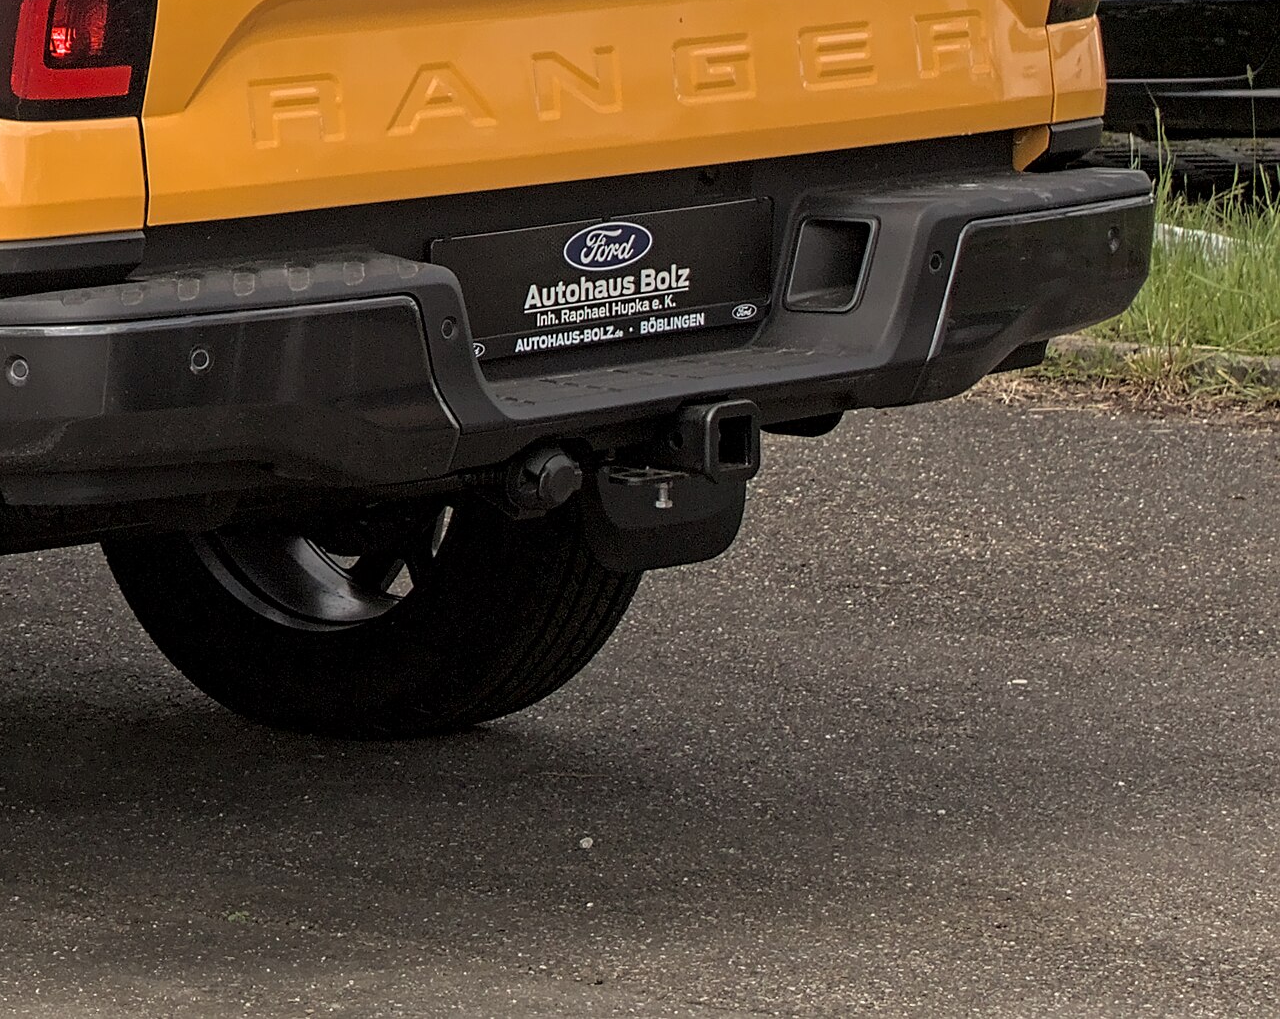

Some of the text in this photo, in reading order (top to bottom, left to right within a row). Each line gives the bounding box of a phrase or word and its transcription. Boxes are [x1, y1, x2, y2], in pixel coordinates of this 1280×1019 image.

[248, 9, 991, 149] RANGER
[579, 228, 637, 265] Ford
[524, 263, 690, 309] Autohaus Bolz
[536, 294, 676, 327] Inh. Raphael Hupka e. K.
[515, 312, 705, 353] AUTOHAUS-BOLZ.de BÖBLINGEN
